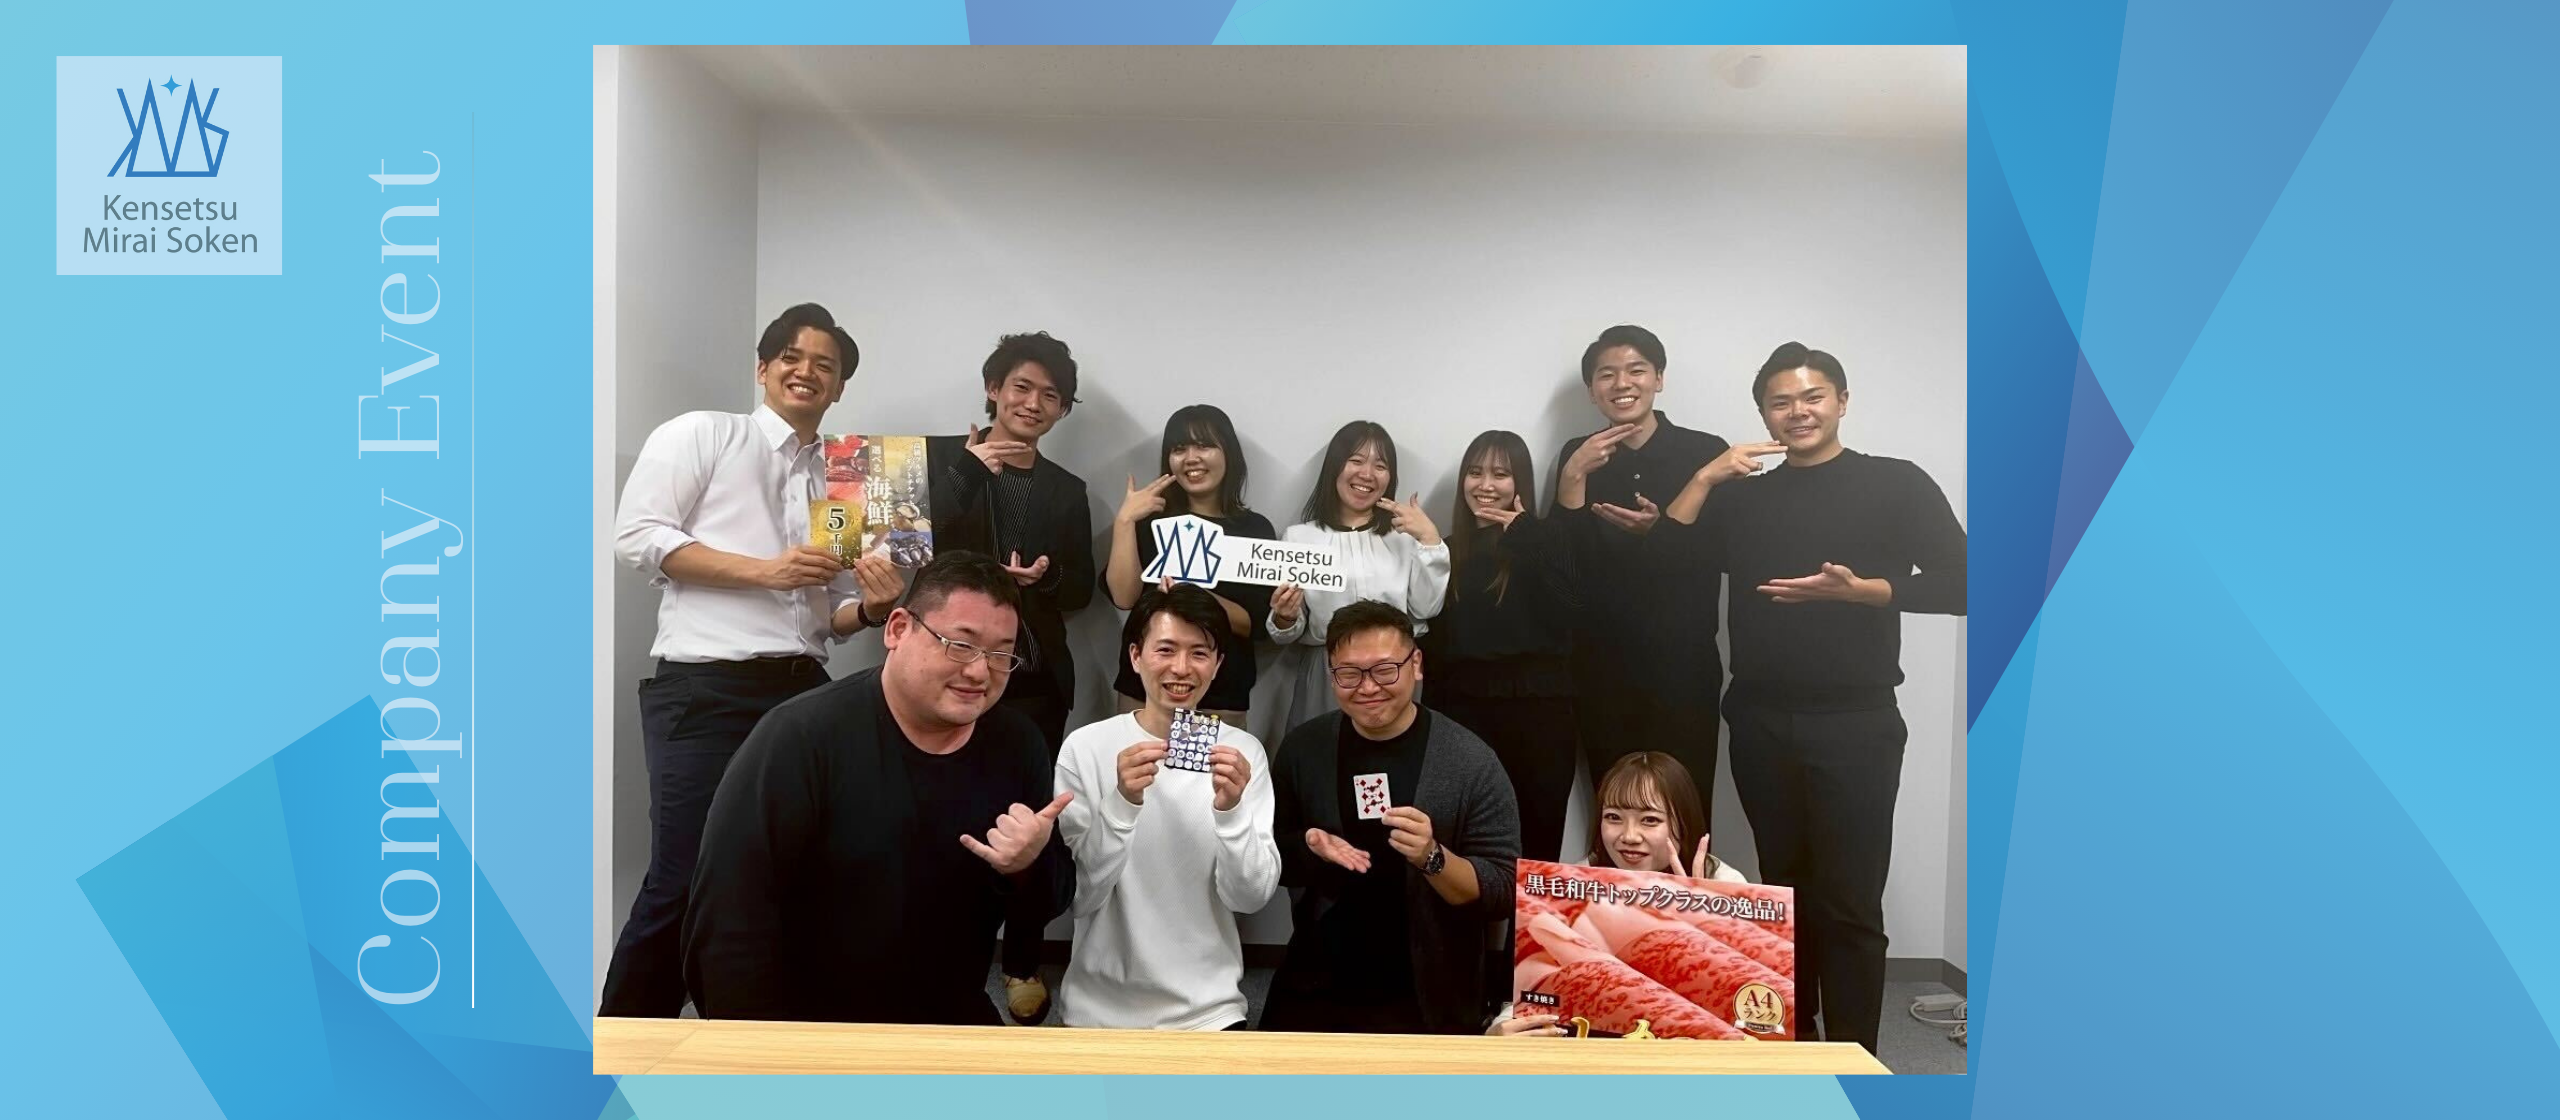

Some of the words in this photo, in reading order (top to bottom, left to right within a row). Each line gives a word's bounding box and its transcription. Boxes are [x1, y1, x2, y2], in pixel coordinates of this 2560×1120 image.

[866, 475, 893, 525] 海鮮
[1251, 543, 1333, 566] Kensetsu
[1236, 561, 1283, 581] Mirai
[1287, 566, 1343, 587] Soken
[1525, 993, 1555, 1005] すき焼き
[1743, 990, 1774, 1009] A4
[1743, 1007, 1776, 1021] ランク
